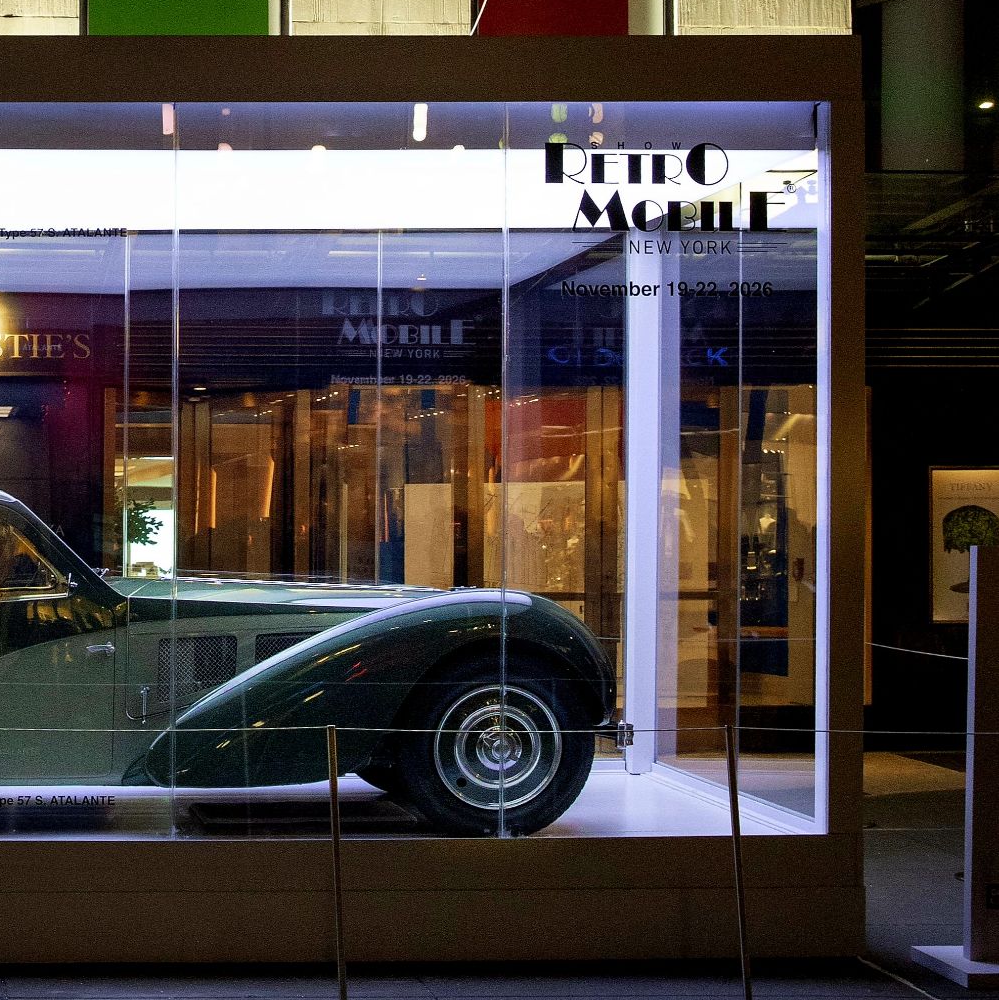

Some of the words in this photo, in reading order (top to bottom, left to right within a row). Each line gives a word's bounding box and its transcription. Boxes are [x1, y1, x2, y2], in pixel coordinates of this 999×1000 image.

[545, 142, 729, 186] RETRO
[0, 228, 27, 240] Type
[30, 228, 44, 238] 57
[62, 227, 128, 238] ATALANTE
[628, 240, 672, 255] NEW
[680, 240, 732, 255] YORK
[561, 281, 661, 298] November
[667, 281, 721, 301] 19-22,
[729, 281, 774, 298] 2026
[17, 795, 32, 806] 57
[51, 795, 116, 806] ATALANTE
